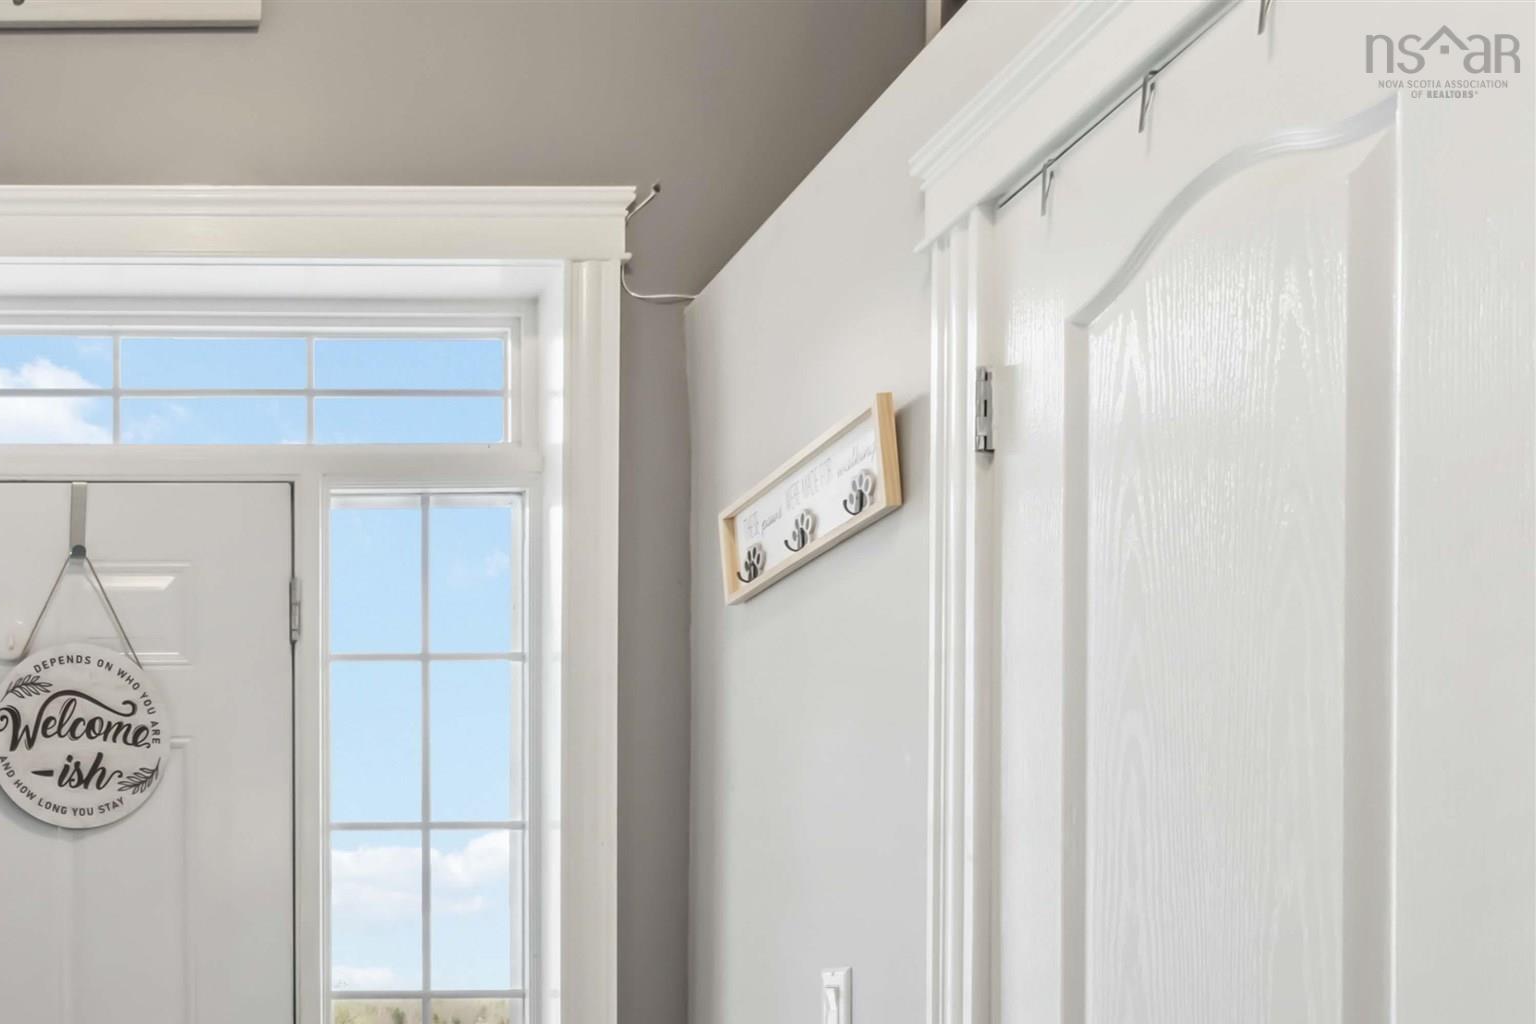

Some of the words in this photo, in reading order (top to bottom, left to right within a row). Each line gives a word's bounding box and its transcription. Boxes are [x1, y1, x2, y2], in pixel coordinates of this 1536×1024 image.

[32, 655, 92, 674] DEPENDS
[96, 658, 114, 672] ON
[116, 668, 141, 691] WHO
[139, 691, 157, 716] YOU
[150, 720, 161, 745] ARE
[13, 778, 37, 801] HOW
[37, 797, 68, 816] LONG
[72, 806, 94, 817] YOU
[98, 796, 125, 815] STAY
